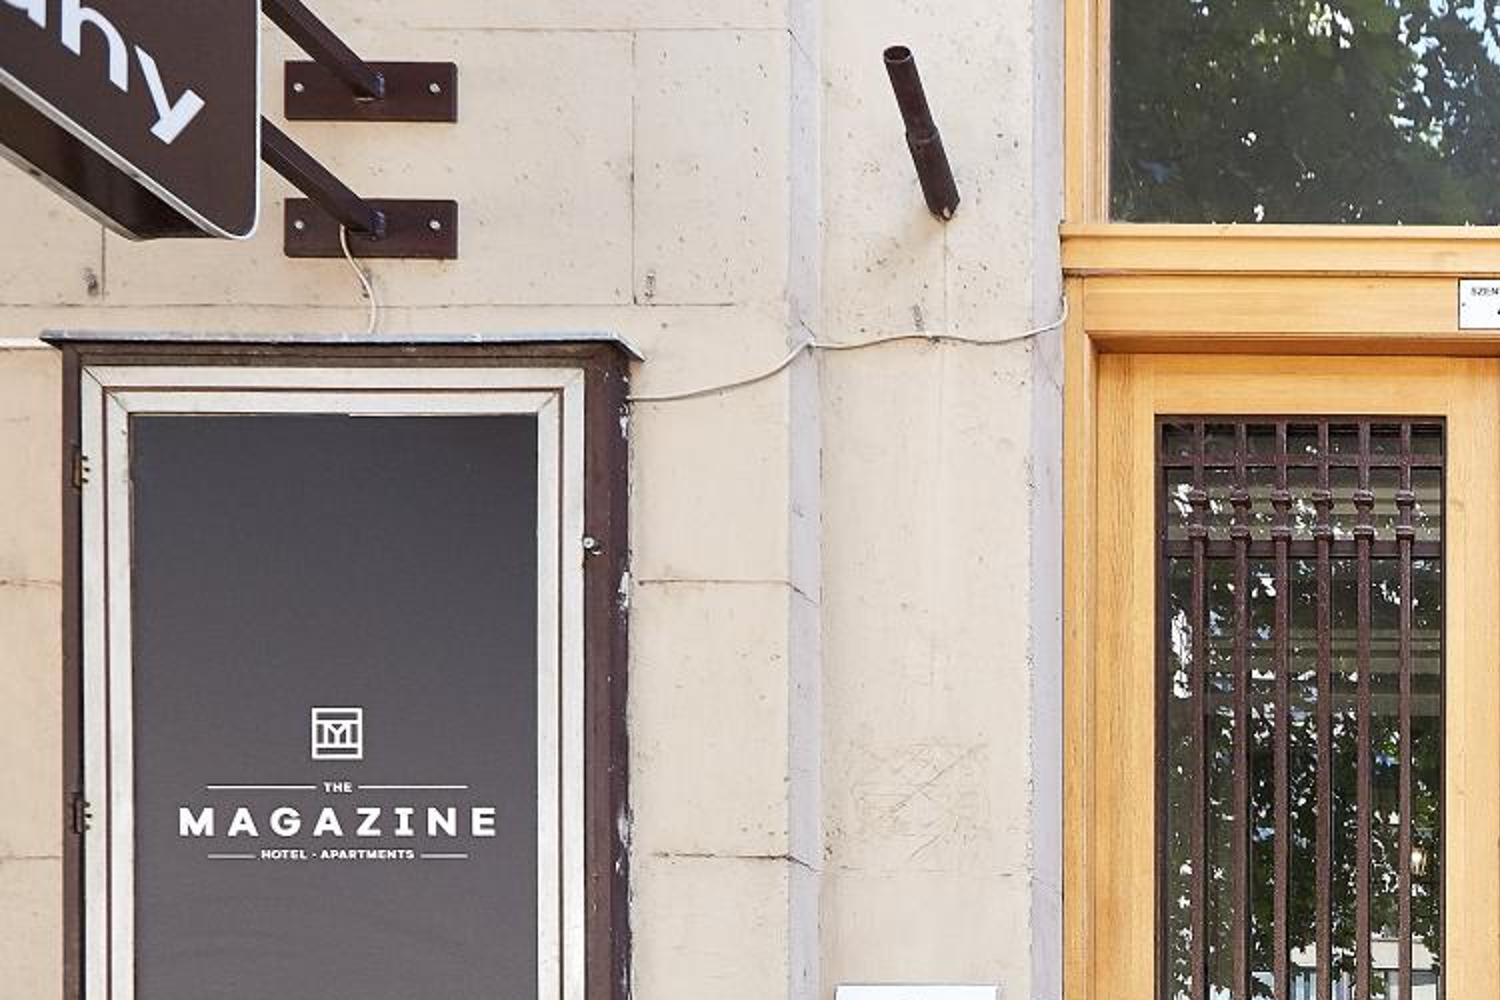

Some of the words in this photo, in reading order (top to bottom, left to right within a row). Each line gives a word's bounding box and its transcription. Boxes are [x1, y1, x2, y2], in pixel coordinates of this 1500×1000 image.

[323, 782, 353, 793] THE
[179, 807, 496, 837] MAGAZINE
[261, 850, 307, 860] HOTEL
[320, 850, 415, 859] APARTMENTS
